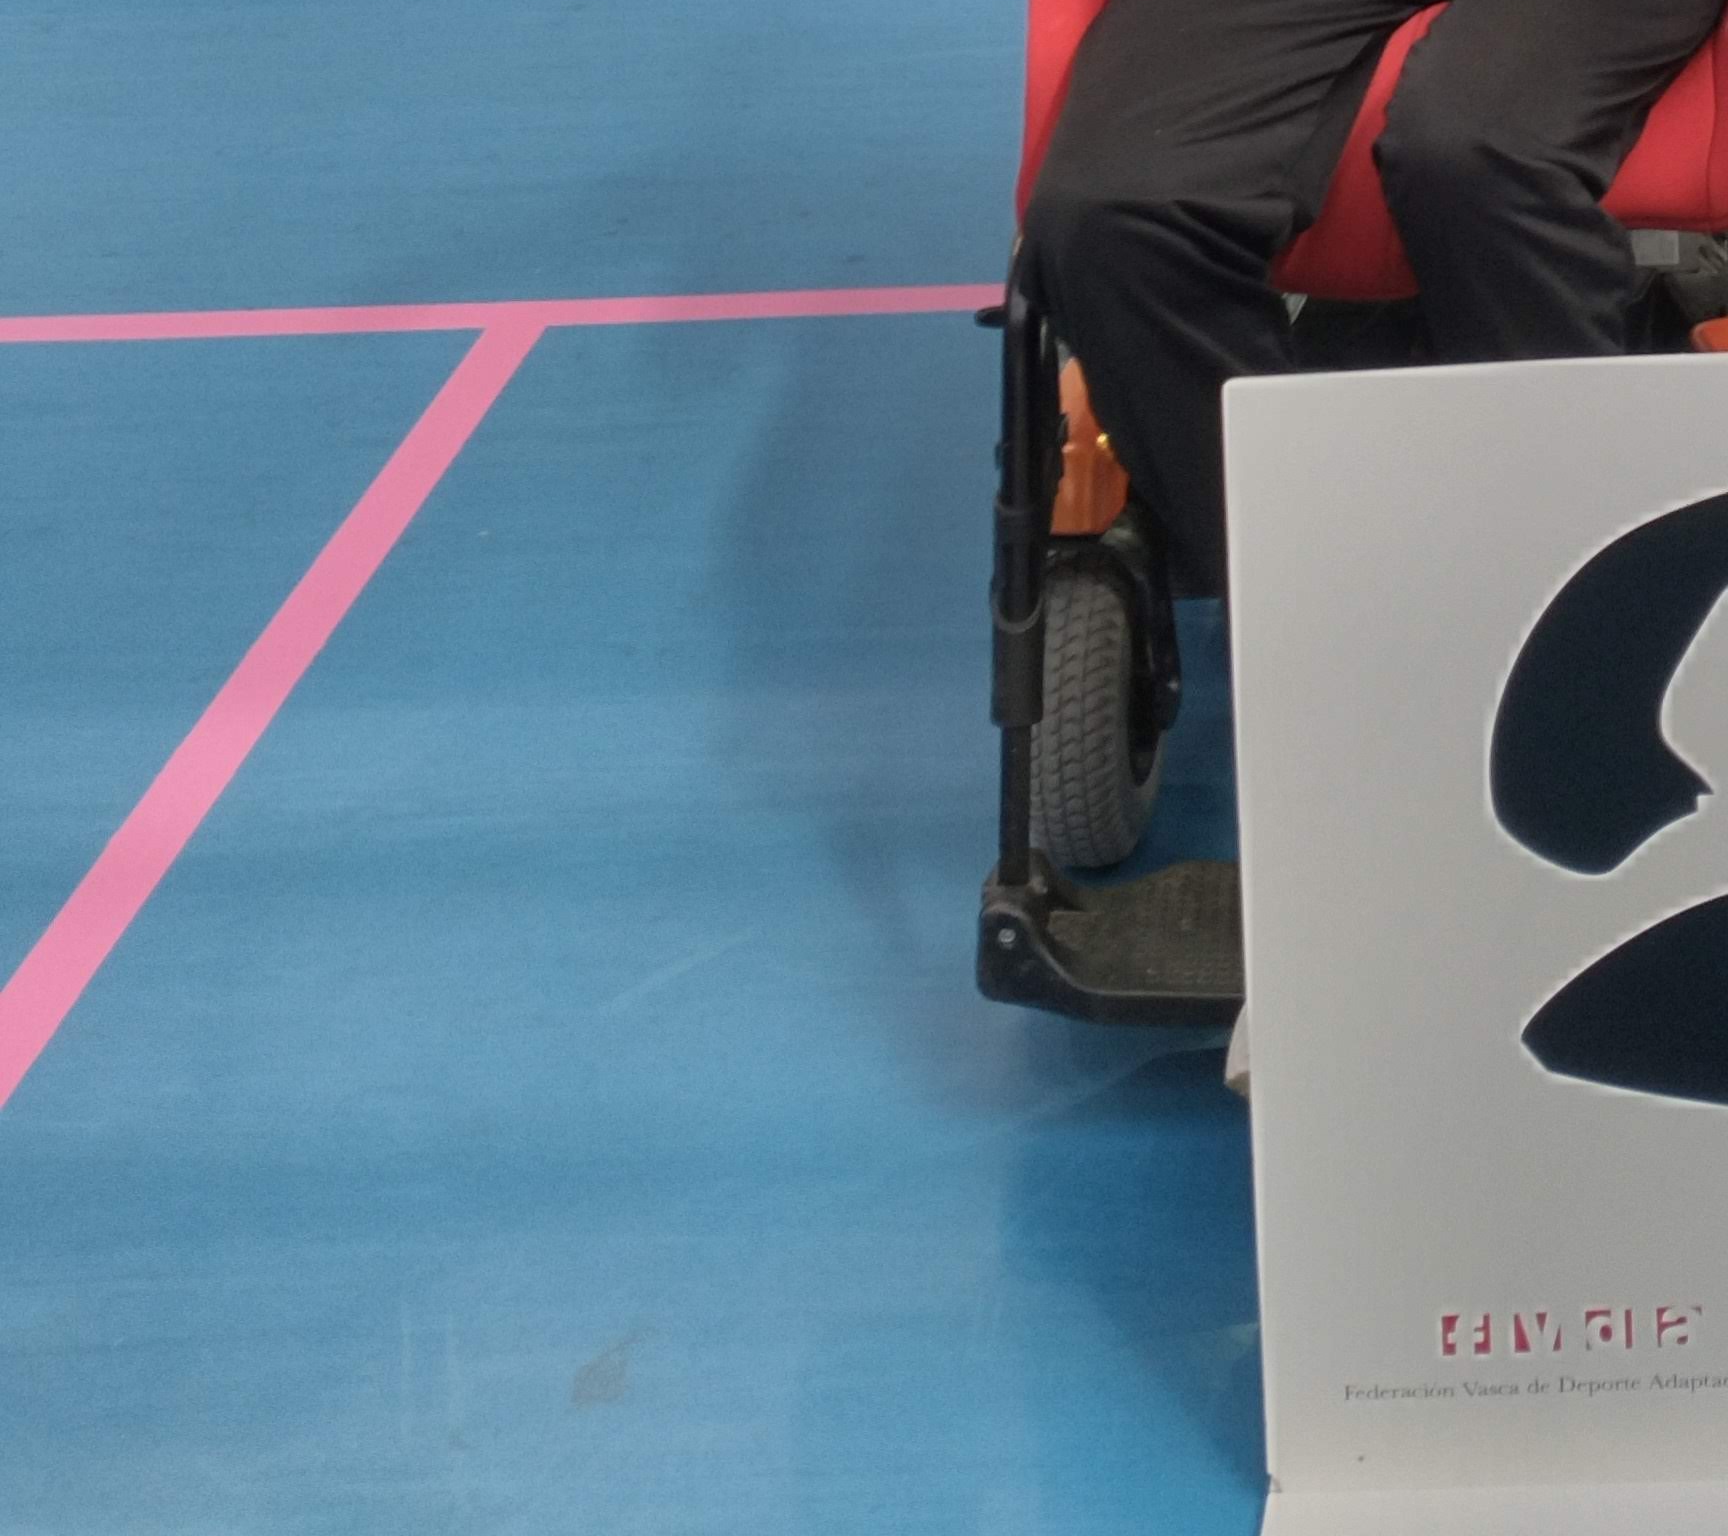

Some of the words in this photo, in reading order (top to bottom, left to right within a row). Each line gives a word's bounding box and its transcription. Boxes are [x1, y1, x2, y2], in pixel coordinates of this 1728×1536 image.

[1345, 1382, 1456, 1401] Federación
[1462, 1381, 1520, 1398] Vasca
[1526, 1378, 1551, 1396] de
[1558, 1375, 1641, 1398] Deporte
